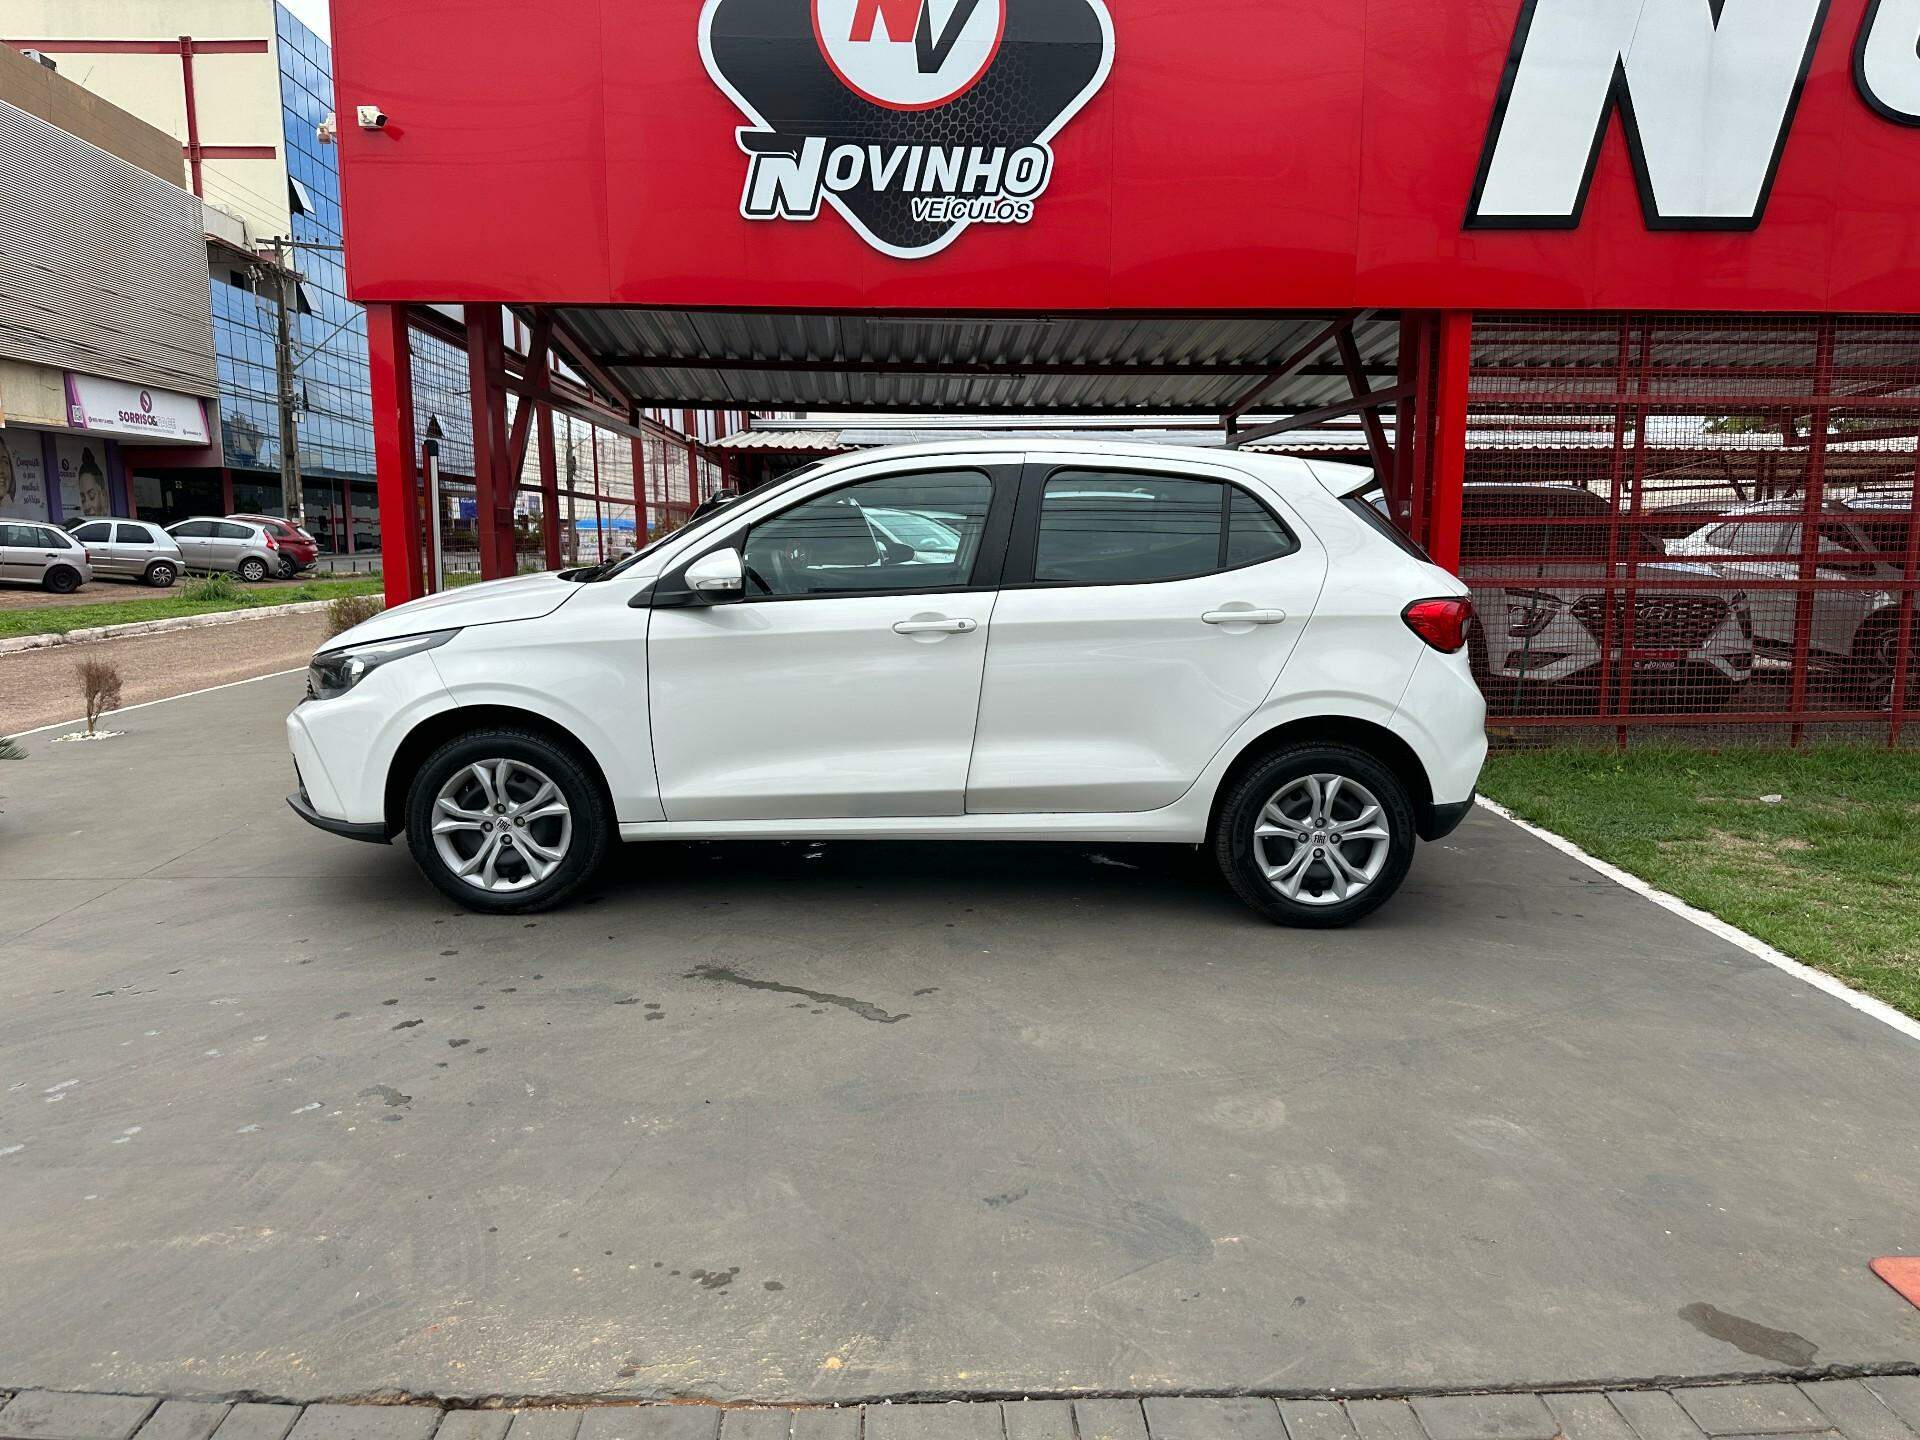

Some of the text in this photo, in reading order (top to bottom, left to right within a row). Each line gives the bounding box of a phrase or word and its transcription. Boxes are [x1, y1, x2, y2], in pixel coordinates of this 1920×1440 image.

[748, 136, 1050, 212] NOVINHO
[913, 196, 1031, 219] VEÍCULOS
[1313, 834, 1328, 845] FIAT
